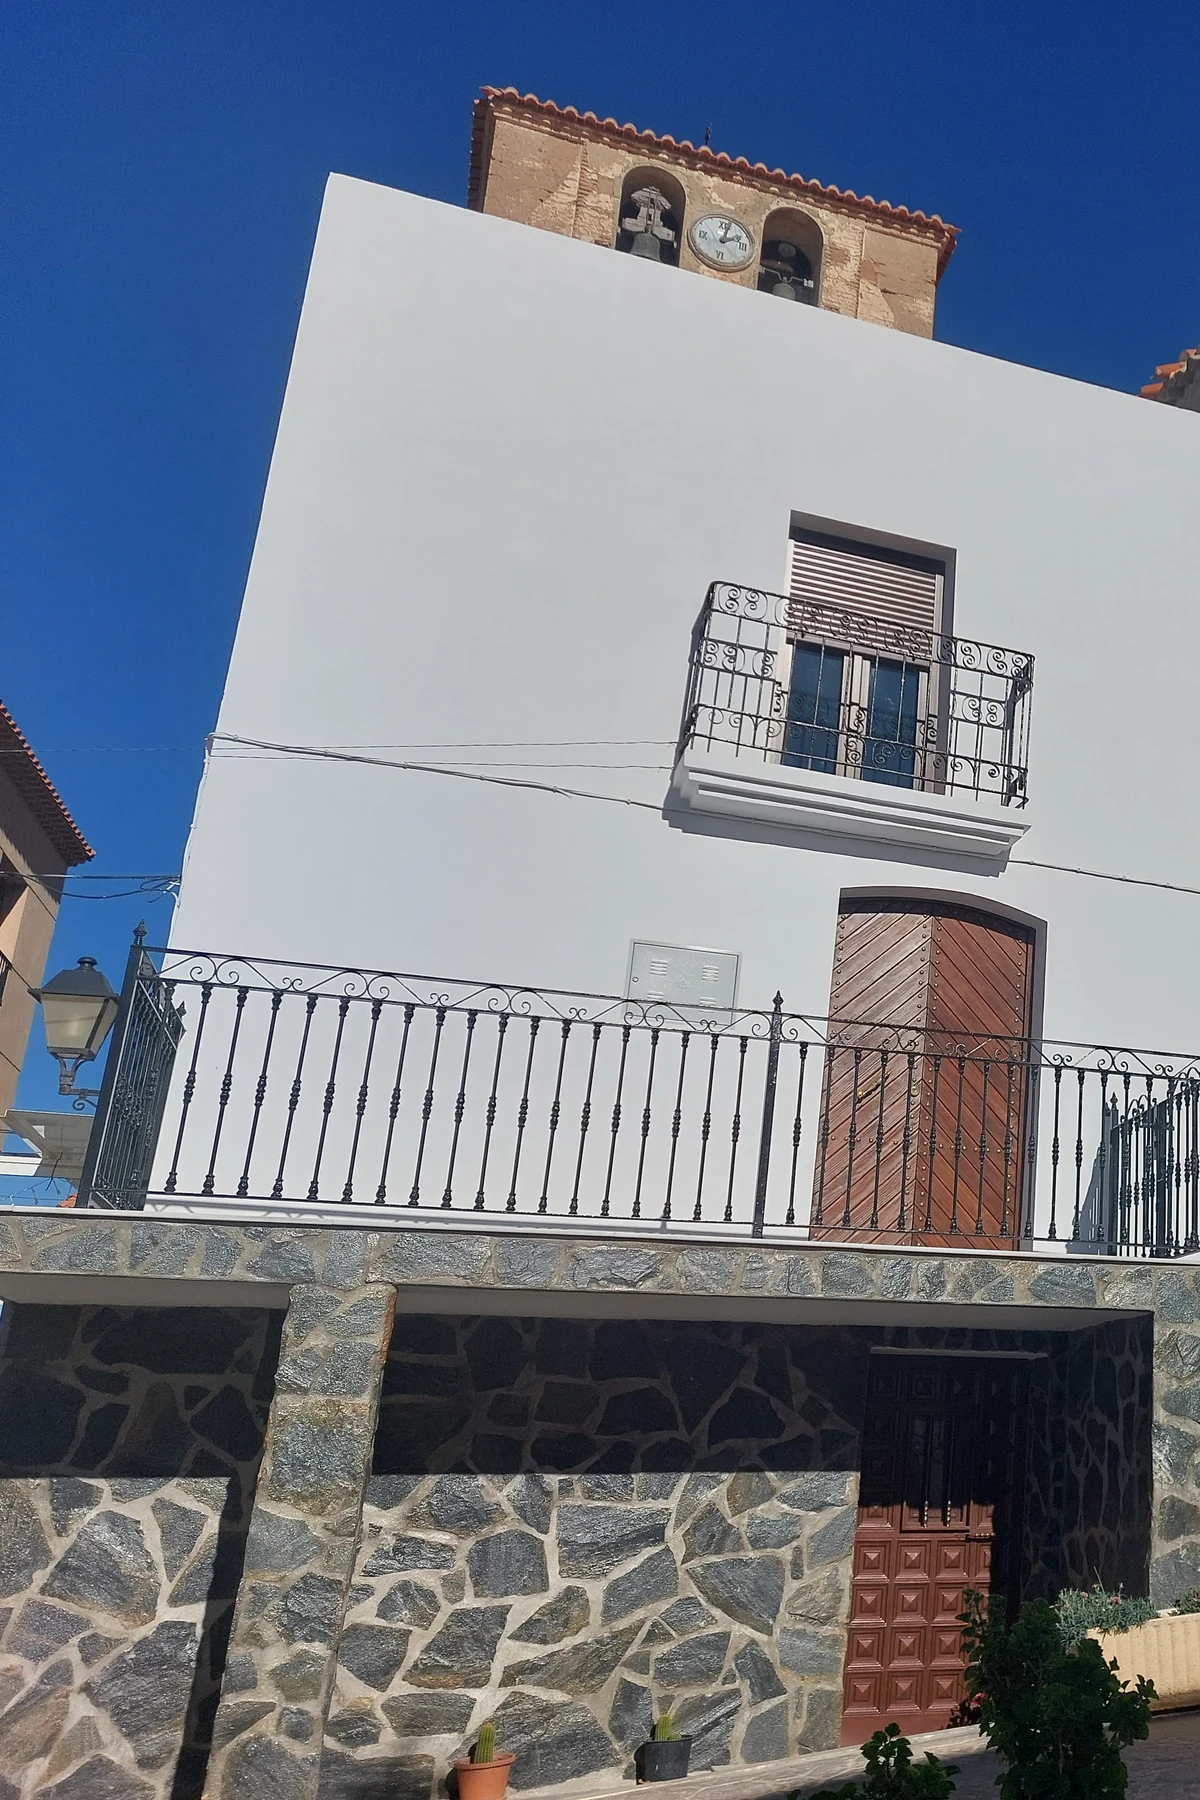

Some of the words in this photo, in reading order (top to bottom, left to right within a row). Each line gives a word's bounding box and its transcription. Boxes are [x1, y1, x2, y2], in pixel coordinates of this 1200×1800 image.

[698, 230, 708, 241] IX
[738, 242, 749, 252] III
[715, 250, 725, 261] VI
